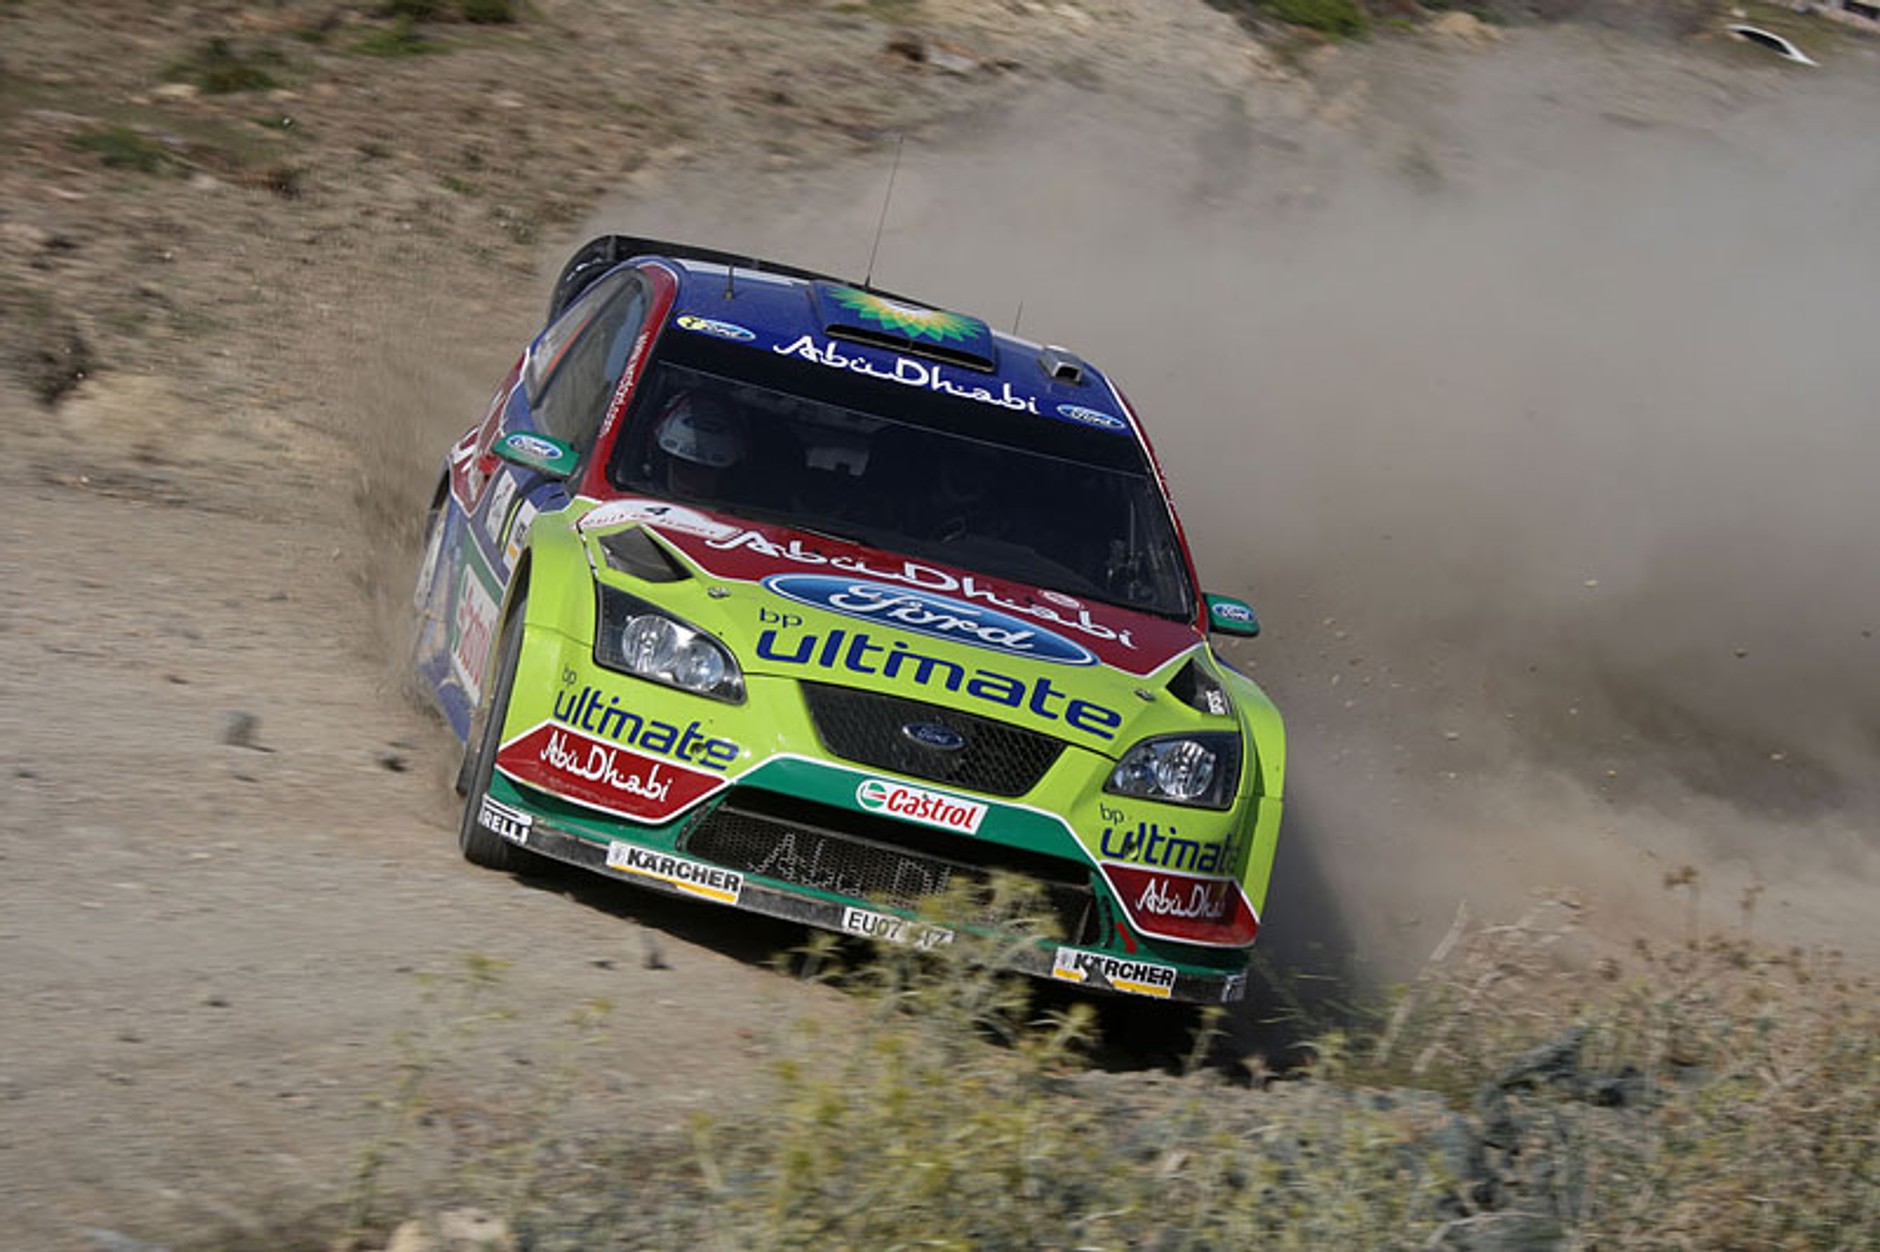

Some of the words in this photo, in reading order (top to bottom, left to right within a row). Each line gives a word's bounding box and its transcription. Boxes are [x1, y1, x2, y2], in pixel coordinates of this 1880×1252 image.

[759, 607, 803, 629] bp
[828, 581, 1035, 652] Ford
[756, 630, 1122, 740] ultimate
[553, 686, 739, 771] ultimate
[887, 789, 977, 829] Castrol
[1100, 803, 1124, 825] bp
[848, 911, 901, 938] EU07
